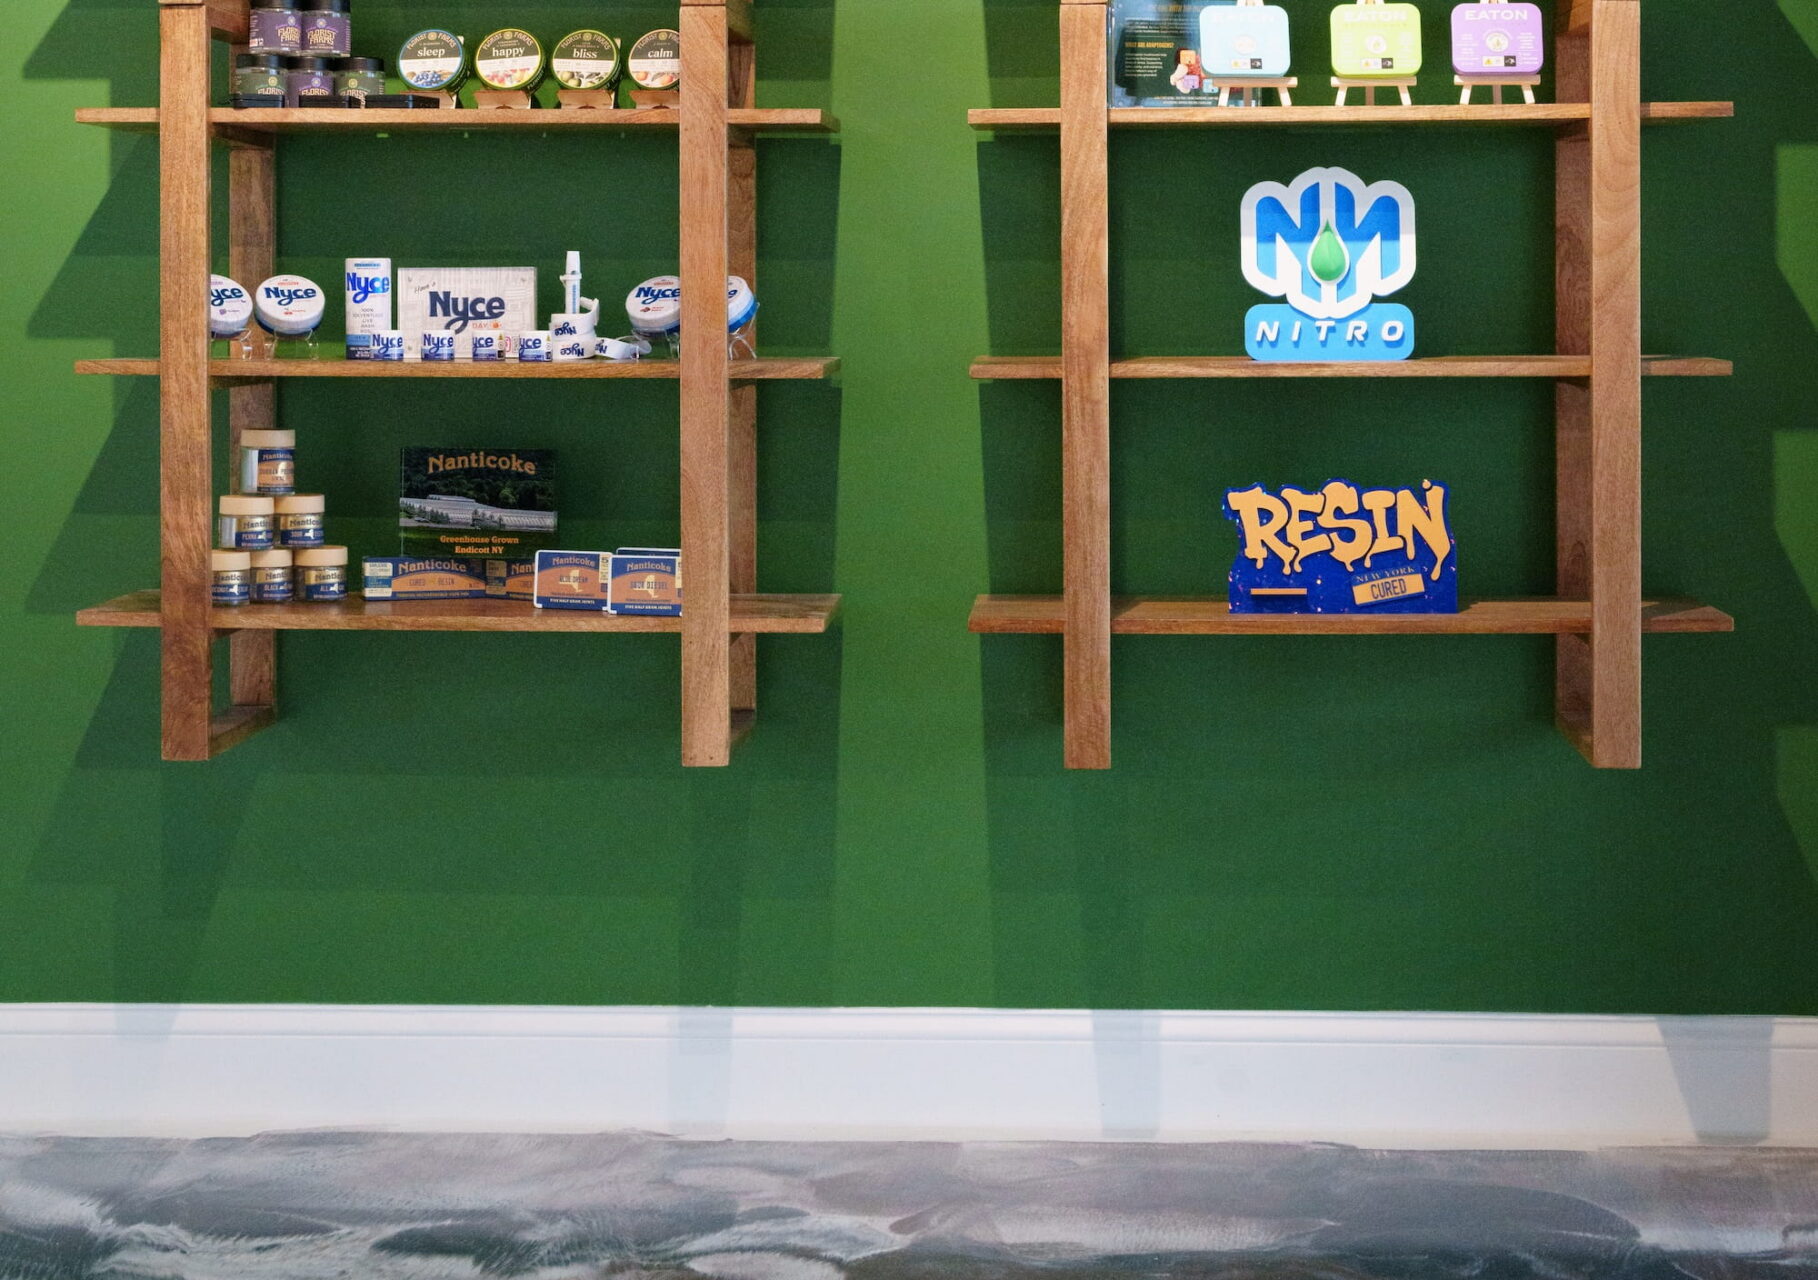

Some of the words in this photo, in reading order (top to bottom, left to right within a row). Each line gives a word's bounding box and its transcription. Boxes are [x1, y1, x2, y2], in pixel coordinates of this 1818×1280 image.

[1465, 9, 1528, 21] EATON
[307, 28, 337, 40] FLORIST
[417, 47, 446, 58] sleep
[492, 47, 525, 58] happy
[572, 48, 598, 59] bliss
[647, 47, 673, 58] calm
[346, 272, 390, 304] Nyce
[635, 286, 680, 305] Nyce
[211, 287, 244, 307] yce
[263, 286, 317, 307] Nyce
[429, 291, 505, 335] Nyce
[1255, 320, 1405, 342] NITRO
[372, 334, 403, 354] Nyce
[423, 333, 454, 355] Nyce
[472, 336, 494, 354] yce
[519, 338, 542, 354] yce
[560, 342, 584, 357] Nyce
[427, 451, 537, 475] Nanticoke
[1228, 479, 1451, 581] RESIN
[440, 535, 490, 544] Greenhouse
[491, 536, 519, 544] Grown
[455, 545, 491, 554] Endicott
[491, 546, 504, 554] NY
[398, 559, 468, 575] Nanticoke
[552, 556, 595, 568] Nanticoke
[626, 561, 671, 572] Nanticoke
[1356, 571, 1383, 583] NEW
[1385, 566, 1415, 579] YORK
[1370, 578, 1407, 600] CURED
